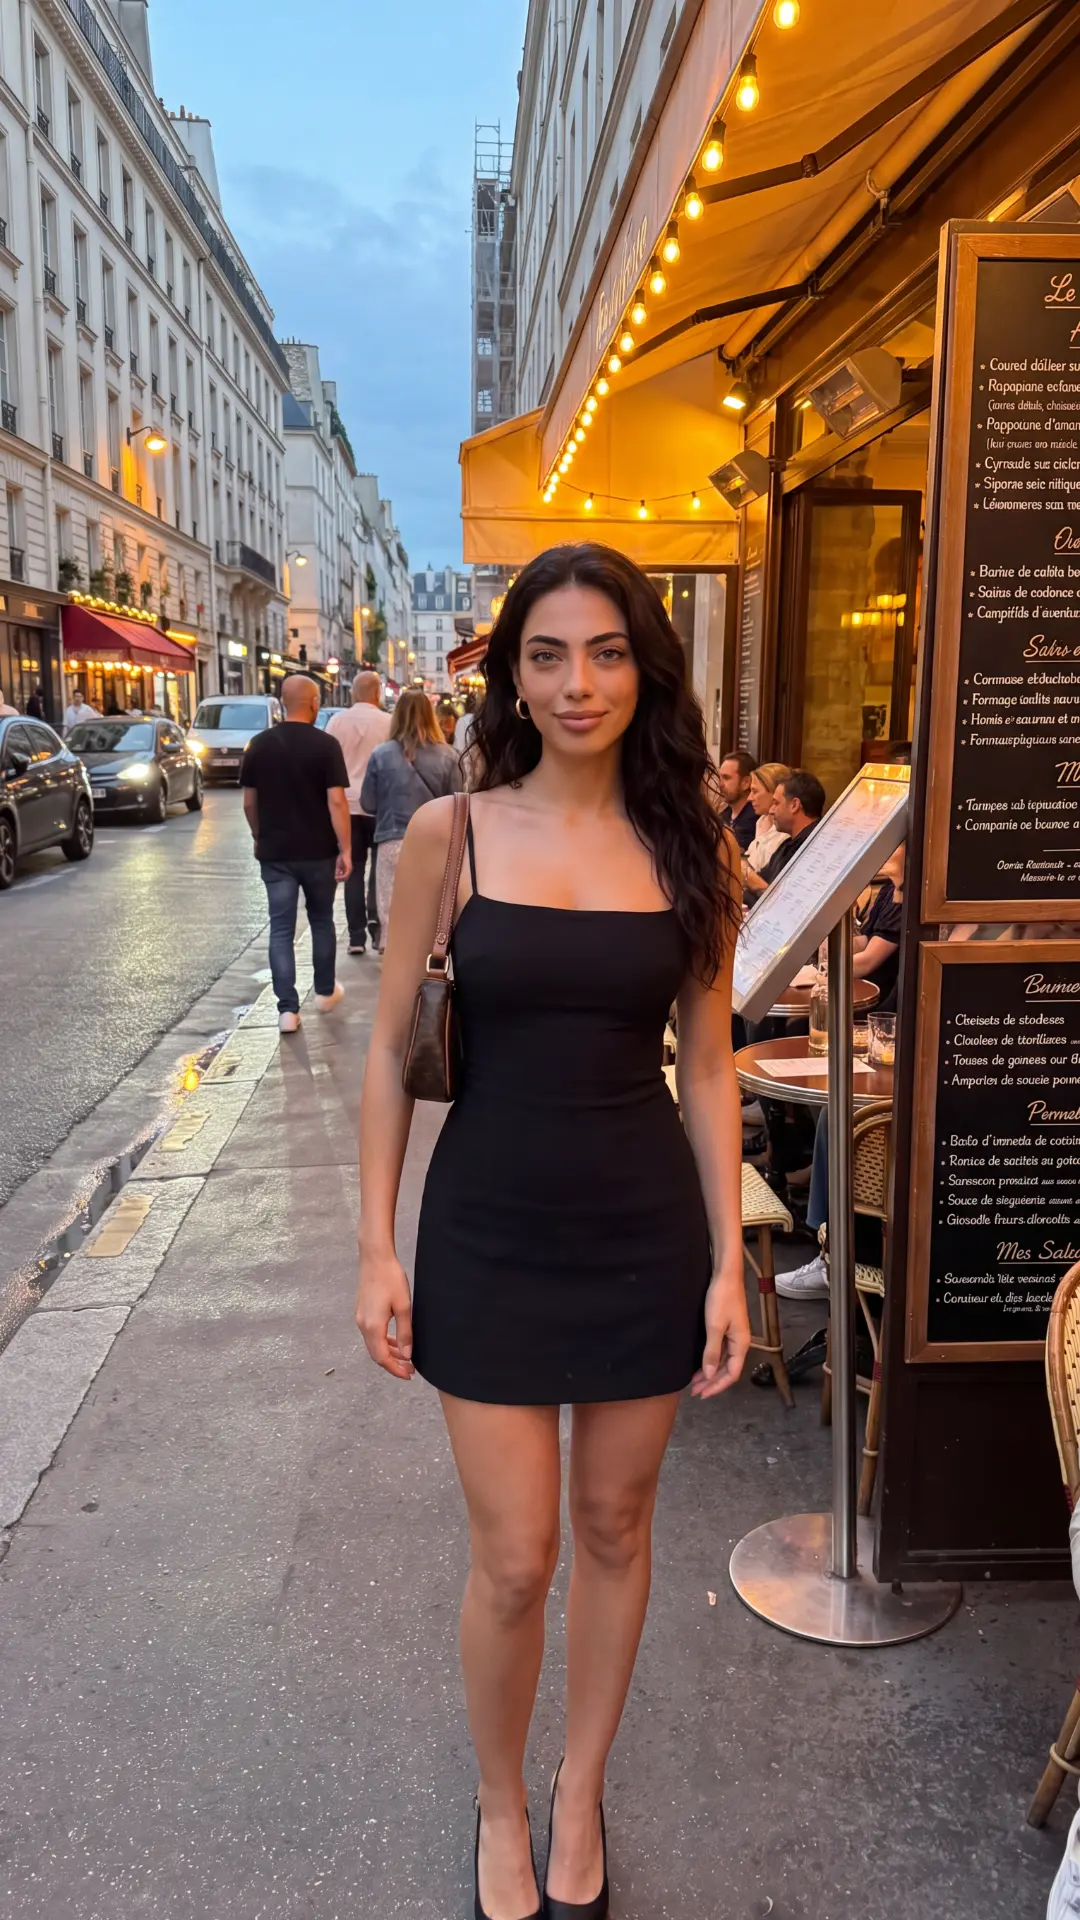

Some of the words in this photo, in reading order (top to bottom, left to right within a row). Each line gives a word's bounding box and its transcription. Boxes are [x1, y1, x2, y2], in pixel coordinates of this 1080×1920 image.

[1044, 272, 1076, 303] Le
[1018, 565, 1031, 577] de
[1014, 586, 1028, 598] de
[971, 692, 1017, 709] Formage
[1003, 1013, 1016, 1025] de
[1001, 1034, 1014, 1045] de
[991, 1054, 1005, 1065] de
[1001, 1074, 1014, 1085] de
[1034, 1134, 1047, 1146] de
[988, 1155, 1001, 1166] de
[980, 1194, 993, 1205] de
[996, 1241, 1032, 1261] Mes
